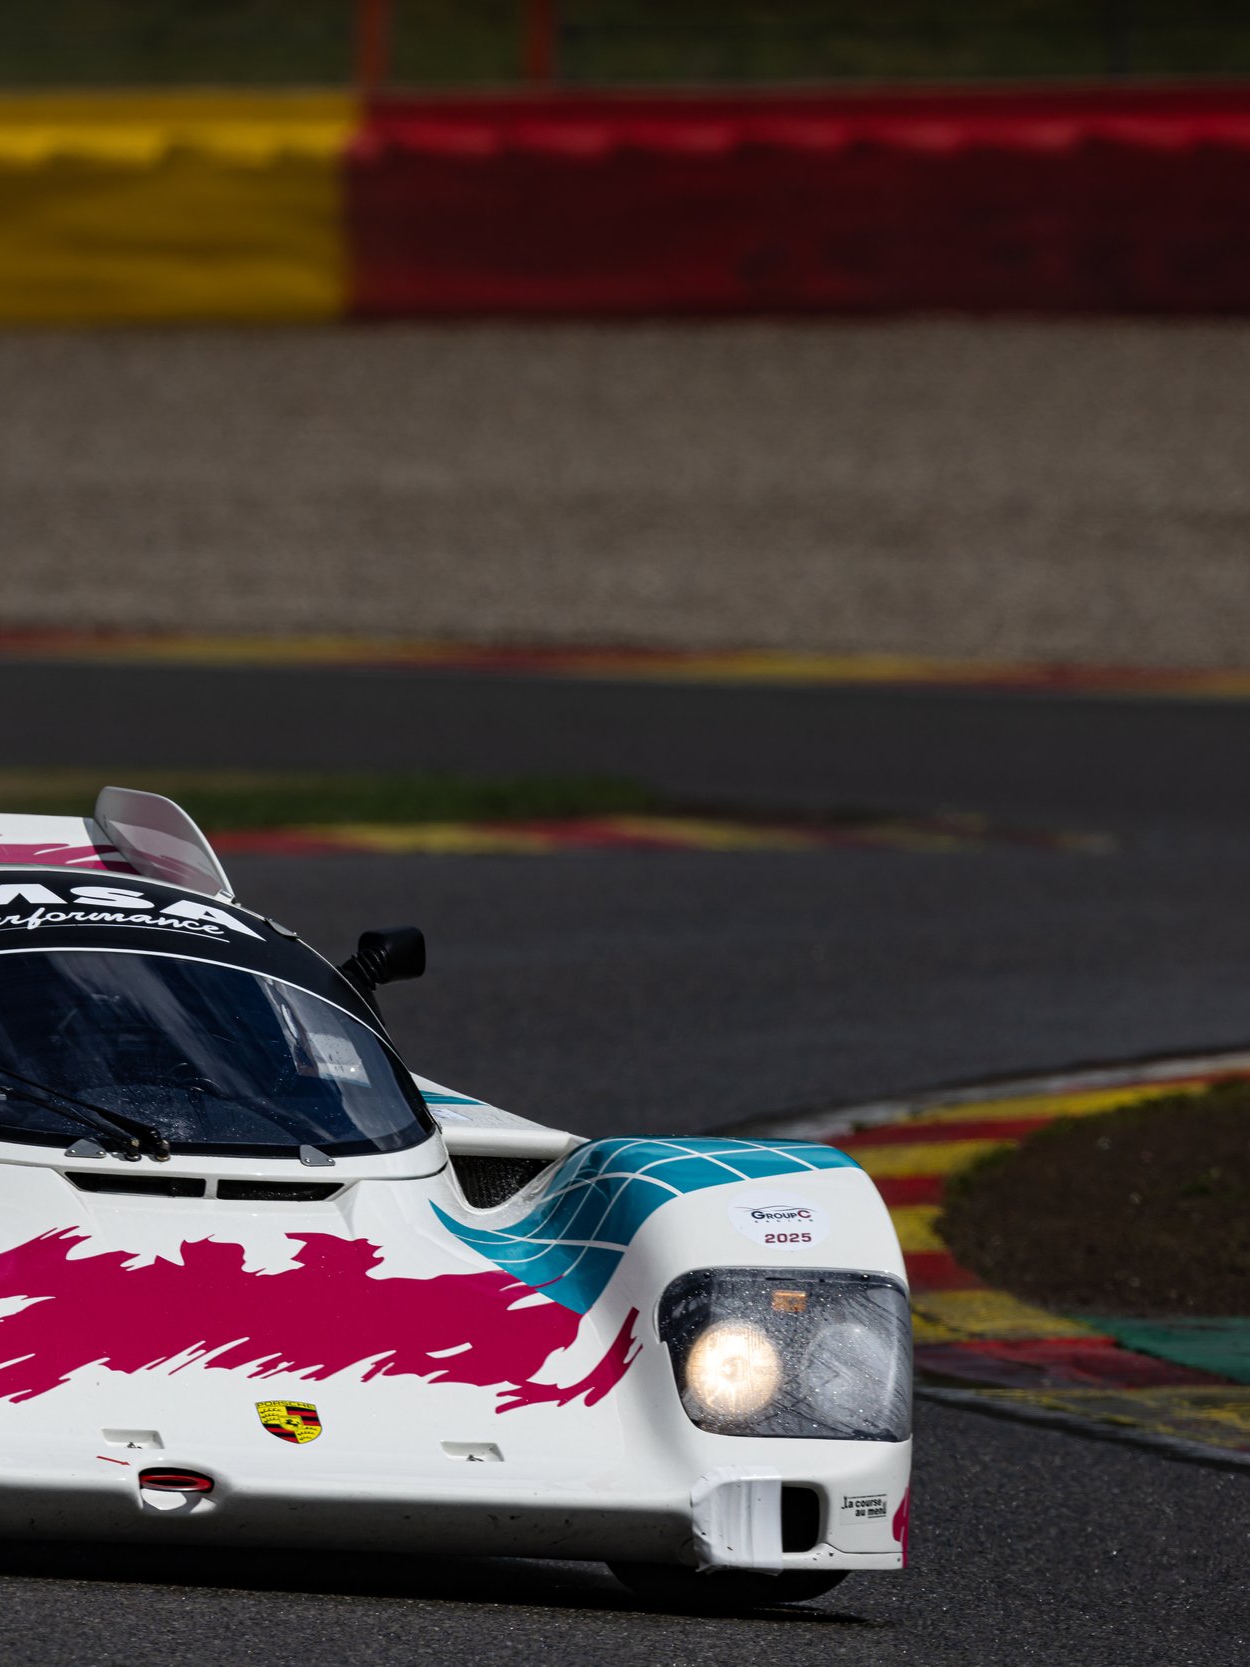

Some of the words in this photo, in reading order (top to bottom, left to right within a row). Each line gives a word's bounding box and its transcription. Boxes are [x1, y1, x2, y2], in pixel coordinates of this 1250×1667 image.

[765, 1232, 812, 1244] 2025
[258, 1401, 315, 1410] PORSCHE
[855, 1499, 881, 1508] course
[855, 1509, 866, 1517] au
